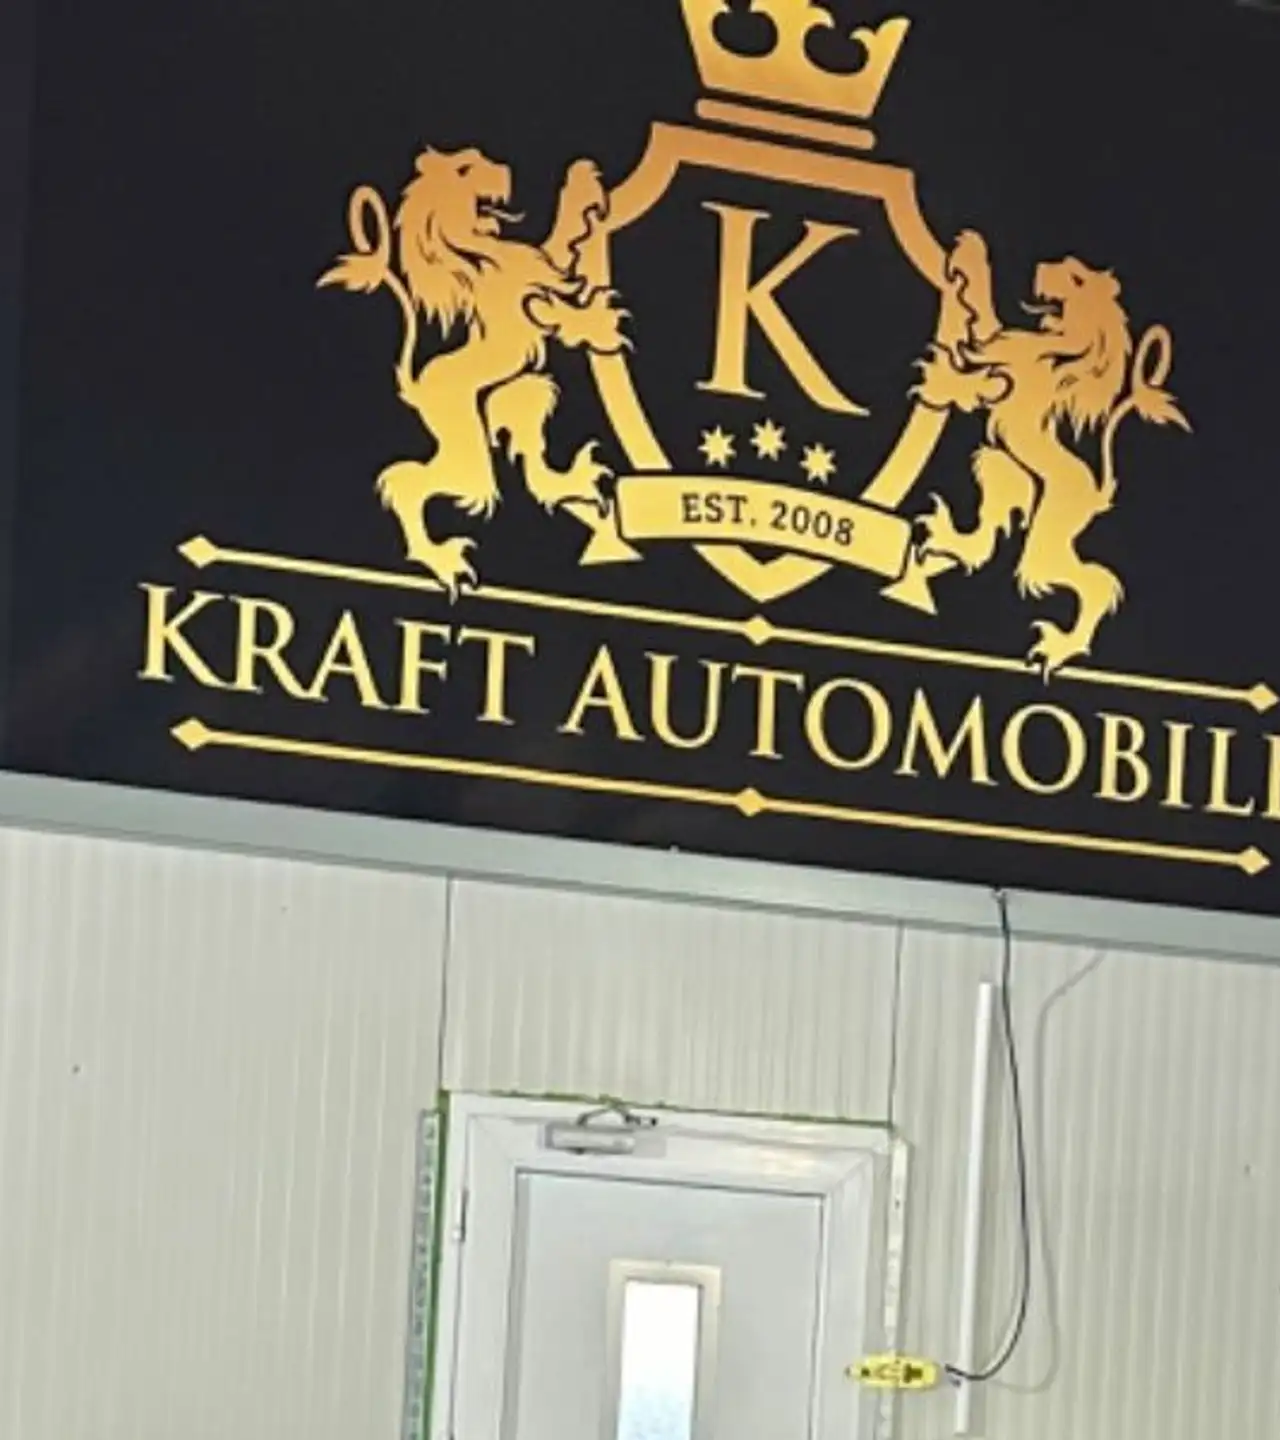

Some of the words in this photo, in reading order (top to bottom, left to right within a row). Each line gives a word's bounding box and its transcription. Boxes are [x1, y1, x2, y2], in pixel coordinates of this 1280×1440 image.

[695, 201, 870, 416] K
[681, 493, 757, 526] EST.
[770, 500, 855, 547] 2008
[138, 583, 535, 725] KRAFT
